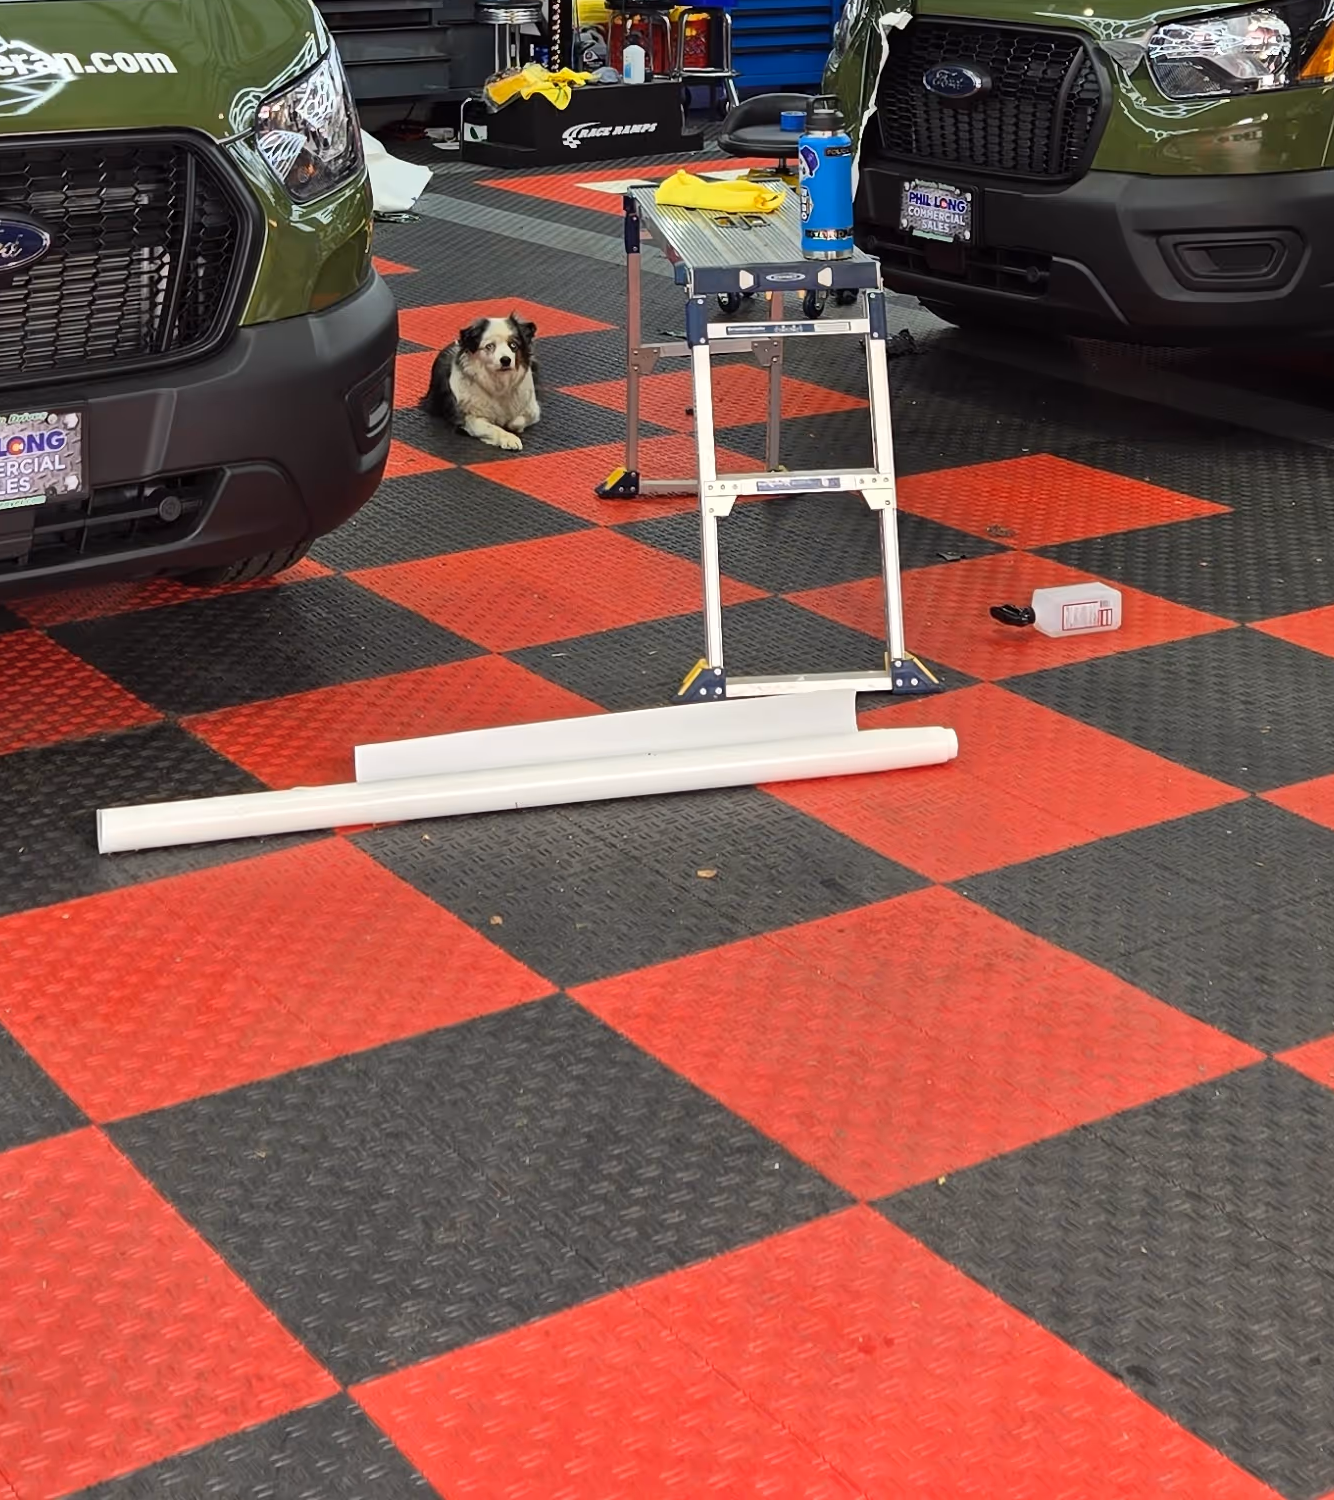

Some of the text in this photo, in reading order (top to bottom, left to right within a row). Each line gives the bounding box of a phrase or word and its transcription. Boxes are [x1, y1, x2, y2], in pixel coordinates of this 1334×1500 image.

[578, 123, 657, 139] RACE RAMPS
[909, 192, 967, 213] PHIL LONG
[908, 206, 966, 226] COMMERCIAL
[921, 221, 950, 233] SALES
